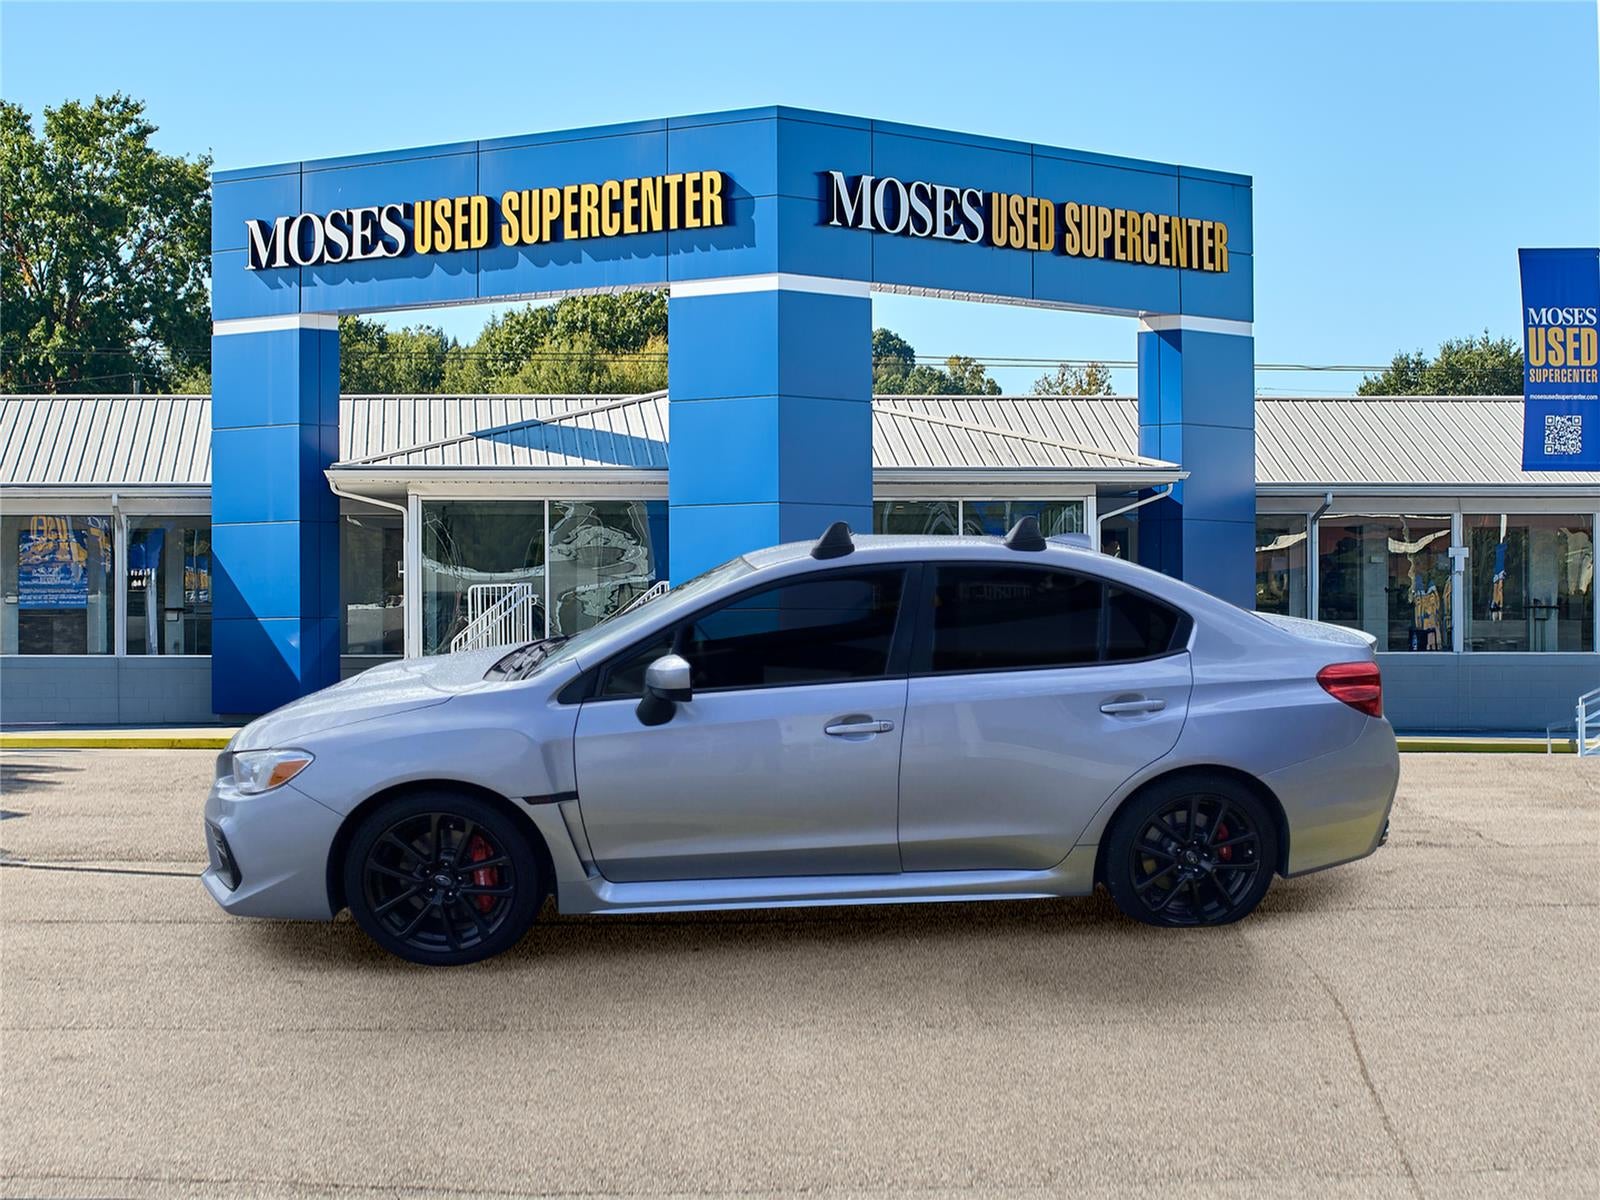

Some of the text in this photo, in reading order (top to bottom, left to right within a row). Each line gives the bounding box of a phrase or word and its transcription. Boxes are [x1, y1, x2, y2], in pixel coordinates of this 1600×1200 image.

[244, 170, 724, 271] MOSES USED SUPERCENTER
[828, 170, 1229, 273] MOSES USED SUPERCENTER
[1527, 307, 1598, 326] MOSES
[1528, 326, 1598, 367] USED
[1529, 368, 1598, 383] SUPERCENTER
